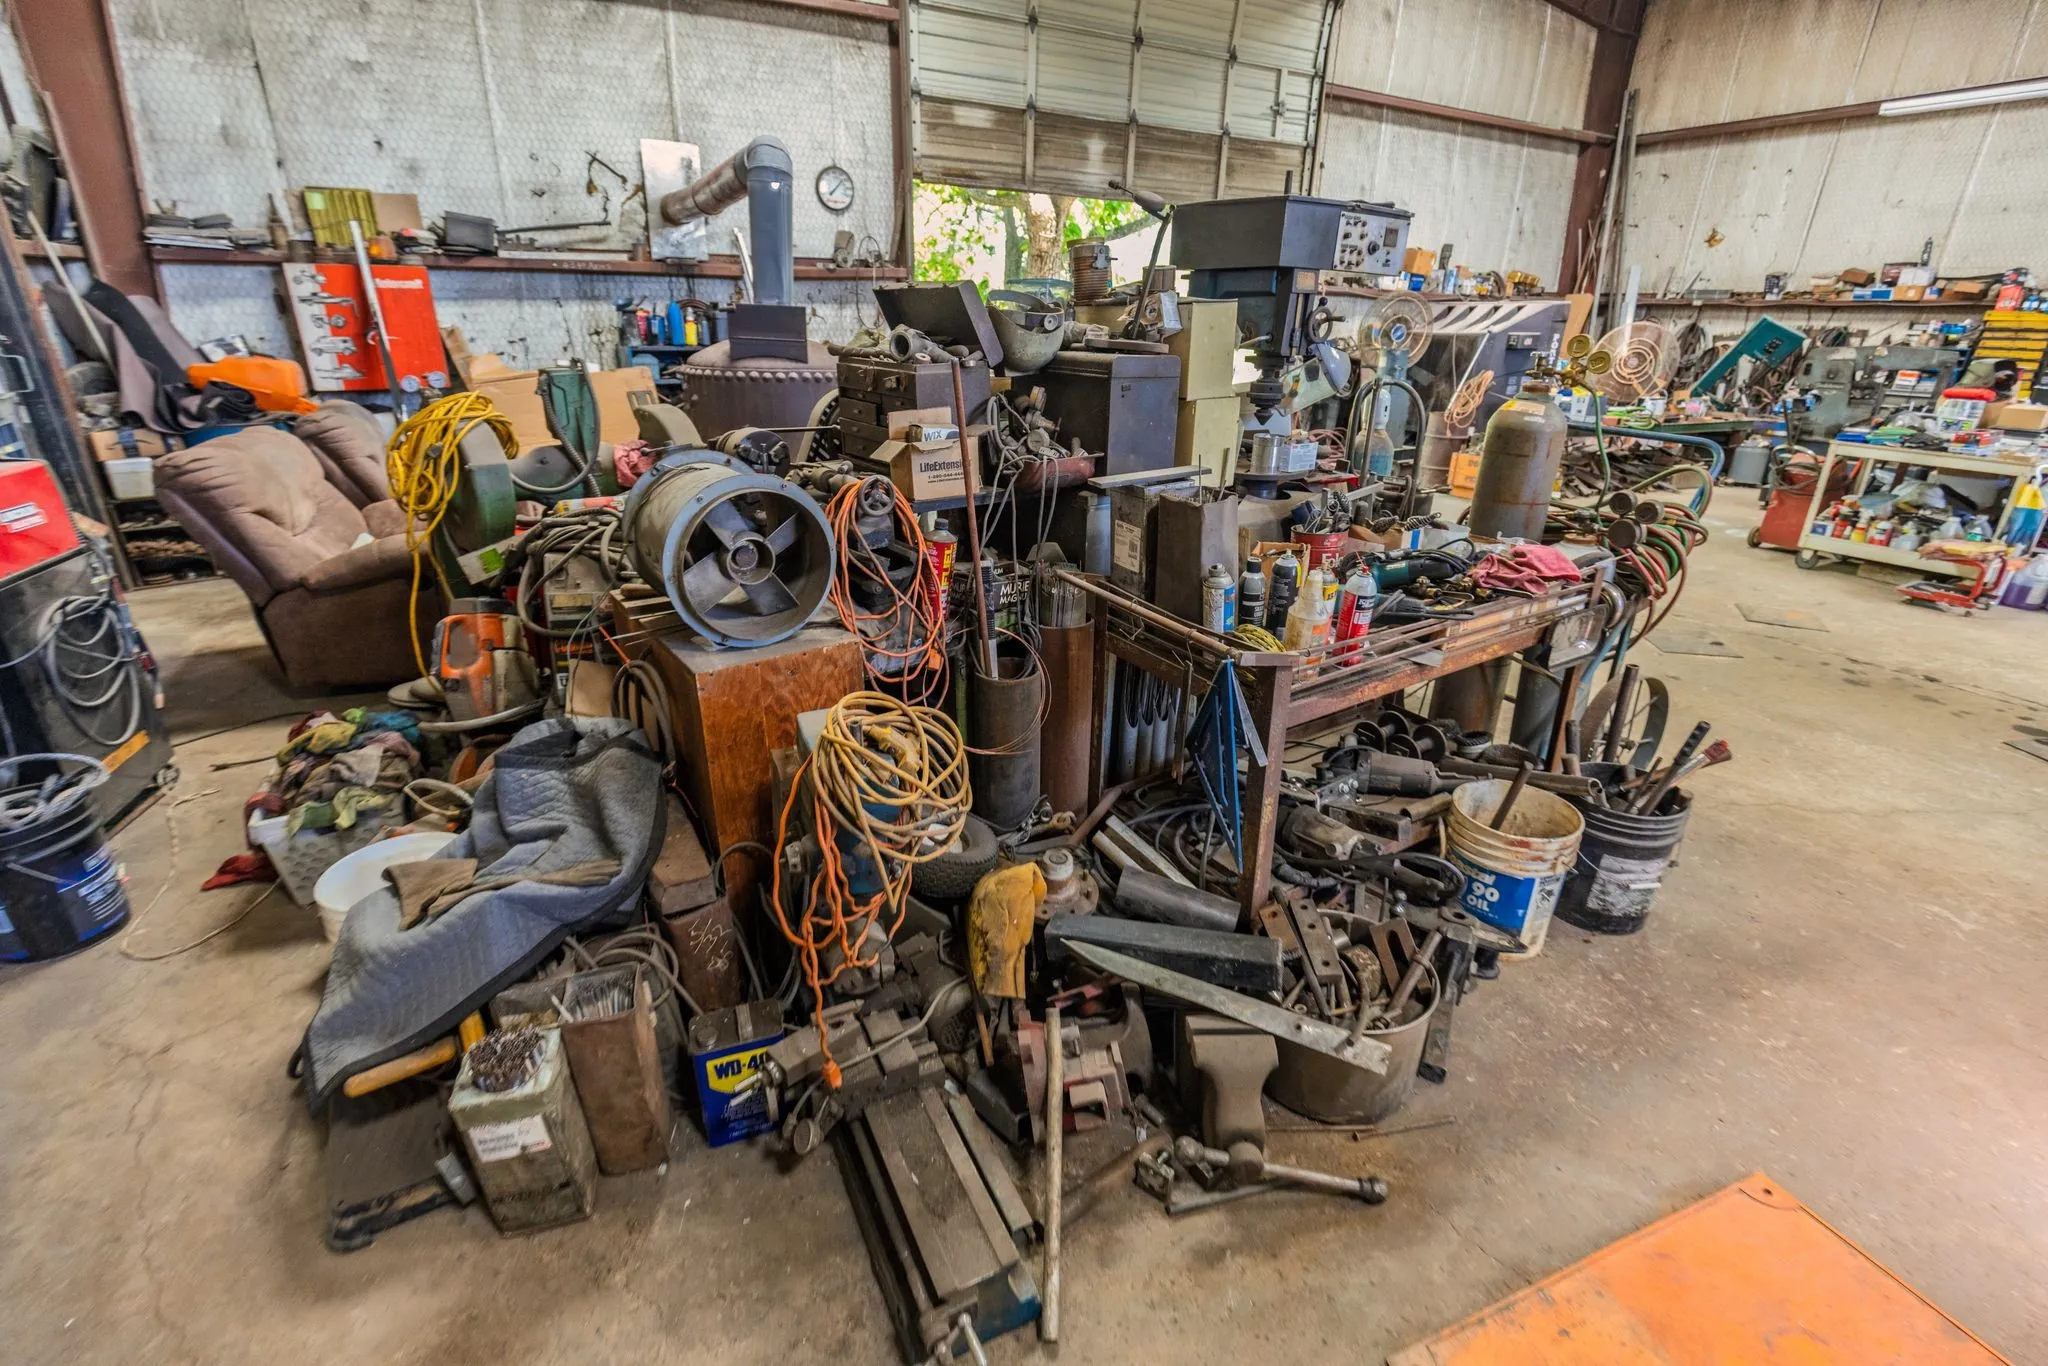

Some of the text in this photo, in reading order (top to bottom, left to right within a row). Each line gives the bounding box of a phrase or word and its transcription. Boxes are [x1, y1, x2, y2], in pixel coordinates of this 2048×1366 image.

[924, 430, 942, 442] WIX
[1000, 581, 1030, 596] MURIE
[1472, 881, 1500, 902] 90
[1466, 894, 1490, 912] OIL
